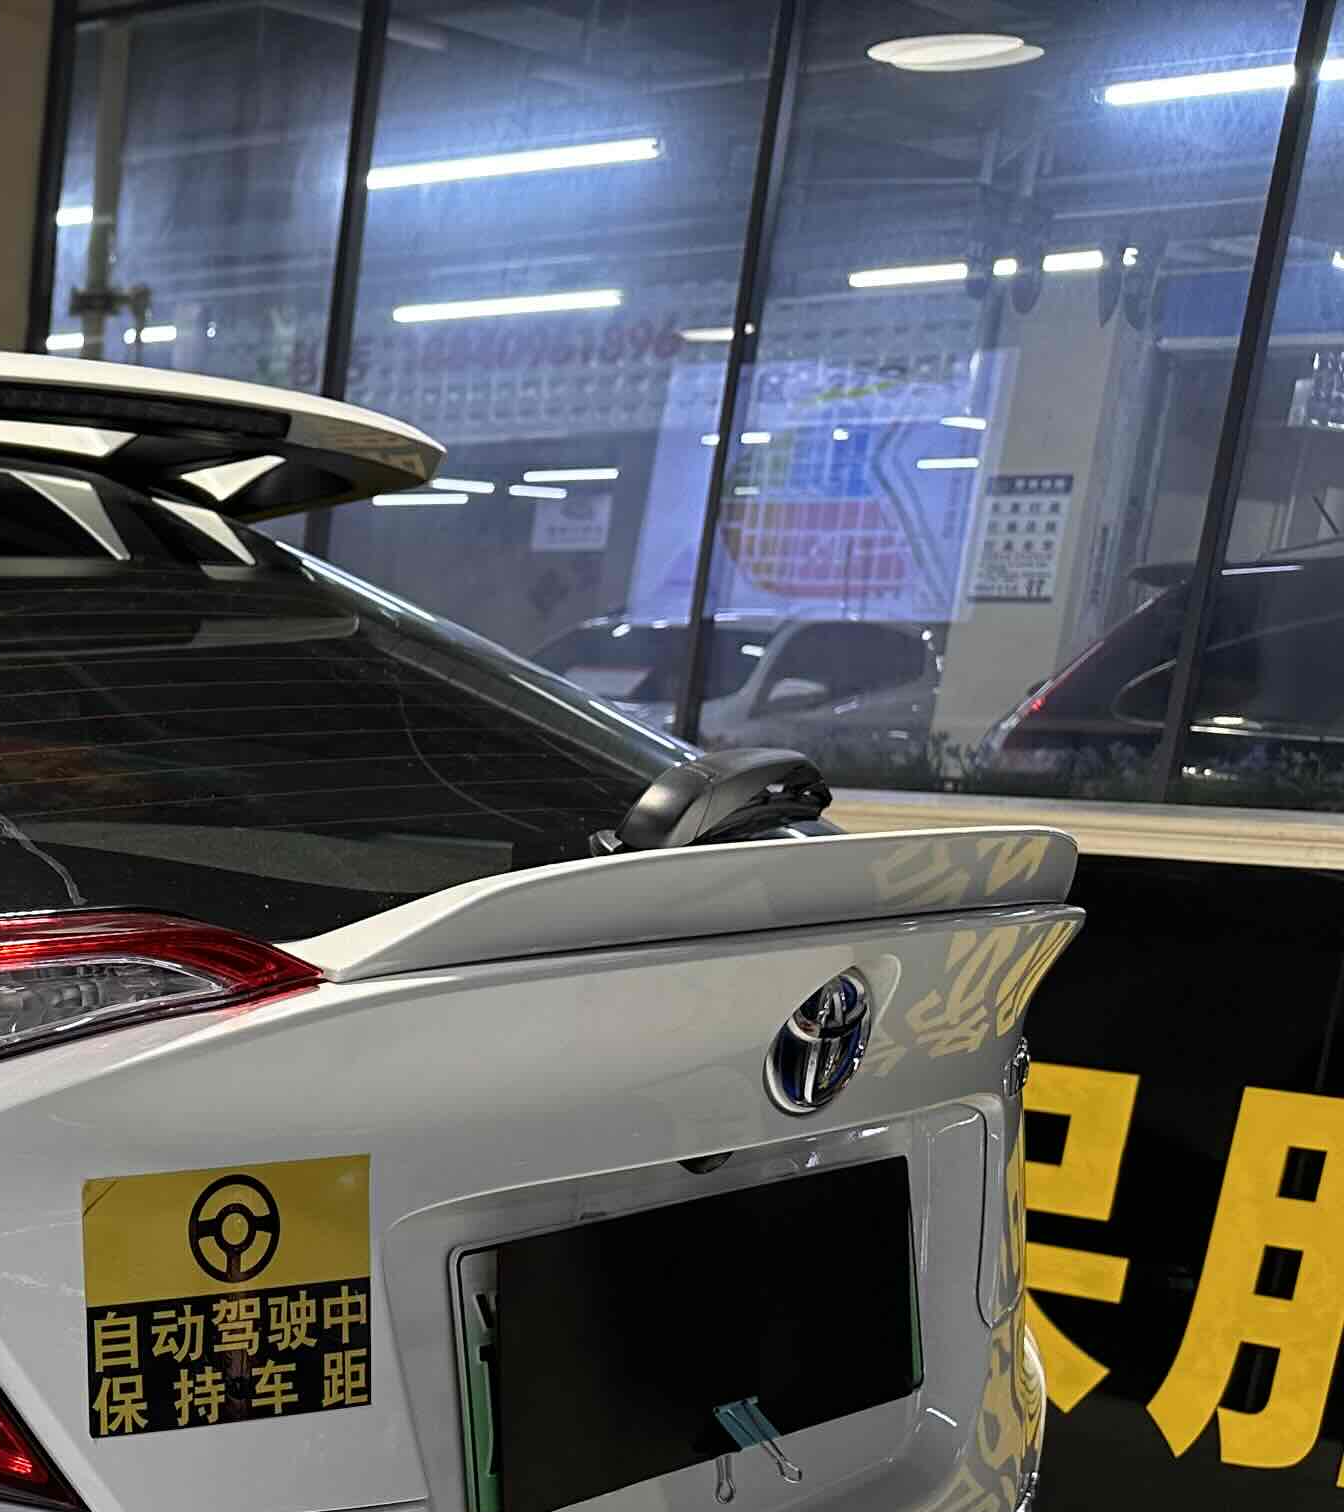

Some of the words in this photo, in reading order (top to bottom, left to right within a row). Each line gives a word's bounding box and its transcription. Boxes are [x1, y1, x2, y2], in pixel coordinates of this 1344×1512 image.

[93, 1285, 368, 1373] 自动驾驶中
[93, 1348, 369, 1435] 保持车距
